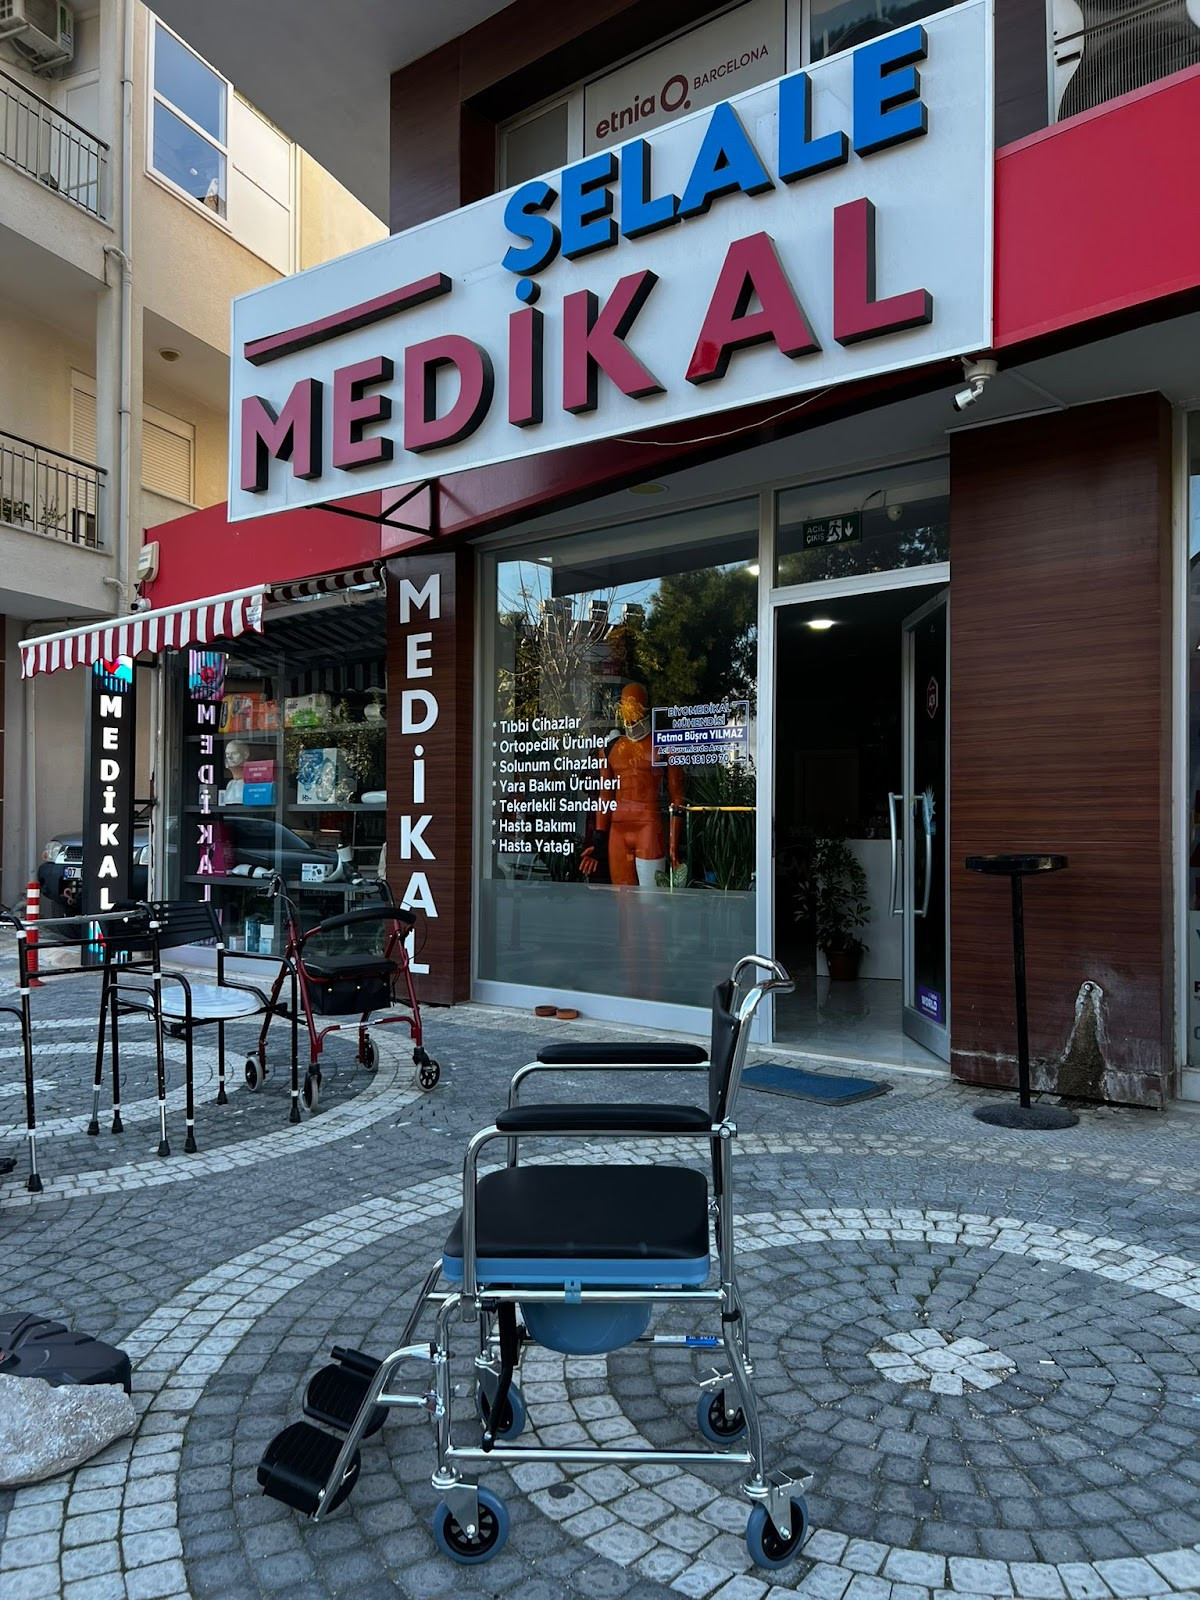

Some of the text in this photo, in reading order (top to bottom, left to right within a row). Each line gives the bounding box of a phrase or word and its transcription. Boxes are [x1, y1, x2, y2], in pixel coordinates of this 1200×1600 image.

[595, 95, 656, 139] etnia
[693, 44, 769, 90] BARCELONA
[240, 196, 934, 493] MEDİKAL
[667, 702, 732, 718] BİYOMEDİKAL
[500, 716, 582, 734] Tıbbi Cihazlar
[672, 714, 727, 729] MÜHENDİSİ
[500, 733, 609, 755] Ortopedik Ürünler
[656, 728, 744, 743] Fatma Büşra YILMAZ
[500, 756, 608, 773] Solunum Cihazları
[668, 755, 691, 766] 0554
[691, 754, 705, 765] 181
[706, 754, 717, 764] 99
[500, 774, 621, 793] Yara Bakım Ürünleri
[97, 694, 123, 911] MEDİKAL
[500, 797, 618, 814] Tekerlekli Sandalye
[499, 818, 576, 832] Hasta Bakımı
[499, 839, 574, 855] Hasta Yatağı
